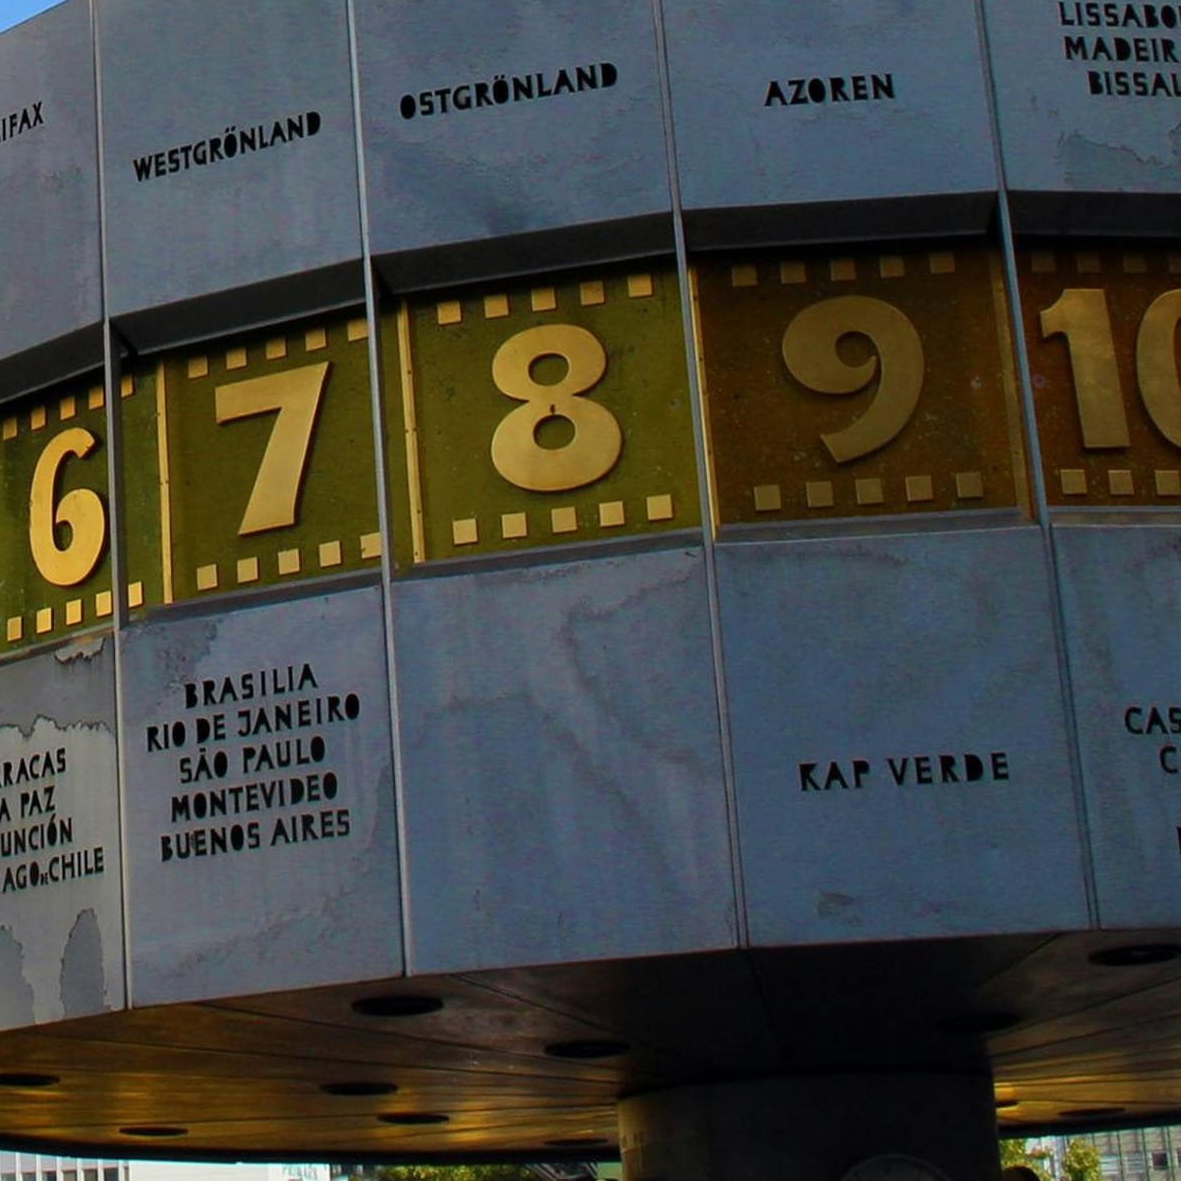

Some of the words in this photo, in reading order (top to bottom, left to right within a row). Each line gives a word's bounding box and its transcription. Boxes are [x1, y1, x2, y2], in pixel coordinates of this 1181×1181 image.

[1059, 1, 1181, 29] LISSABO
[400, 62, 618, 119] OSTGRÖNLAND
[764, 72, 895, 107] AZOREN
[133, 111, 321, 183] WESTGRÖNLAND
[30, 427, 105, 586] 6
[215, 361, 330, 536] 7
[491, 324, 621, 492] 8
[781, 295, 925, 463] 9
[185, 663, 318, 709] BRASILIA
[147, 721, 186, 752] RIO
[196, 715, 226, 744] DE
[238, 694, 360, 737] JANEIRO
[243, 736, 325, 773] PAULO
[799, 761, 870, 791] KAP
[887, 752, 1009, 786] VERDE
[21, 786, 56, 818] PAZ
[171, 772, 338, 823] MONTEVIDEO
[161, 823, 260, 862] BUENOS
[271, 809, 350, 846] AIRES
